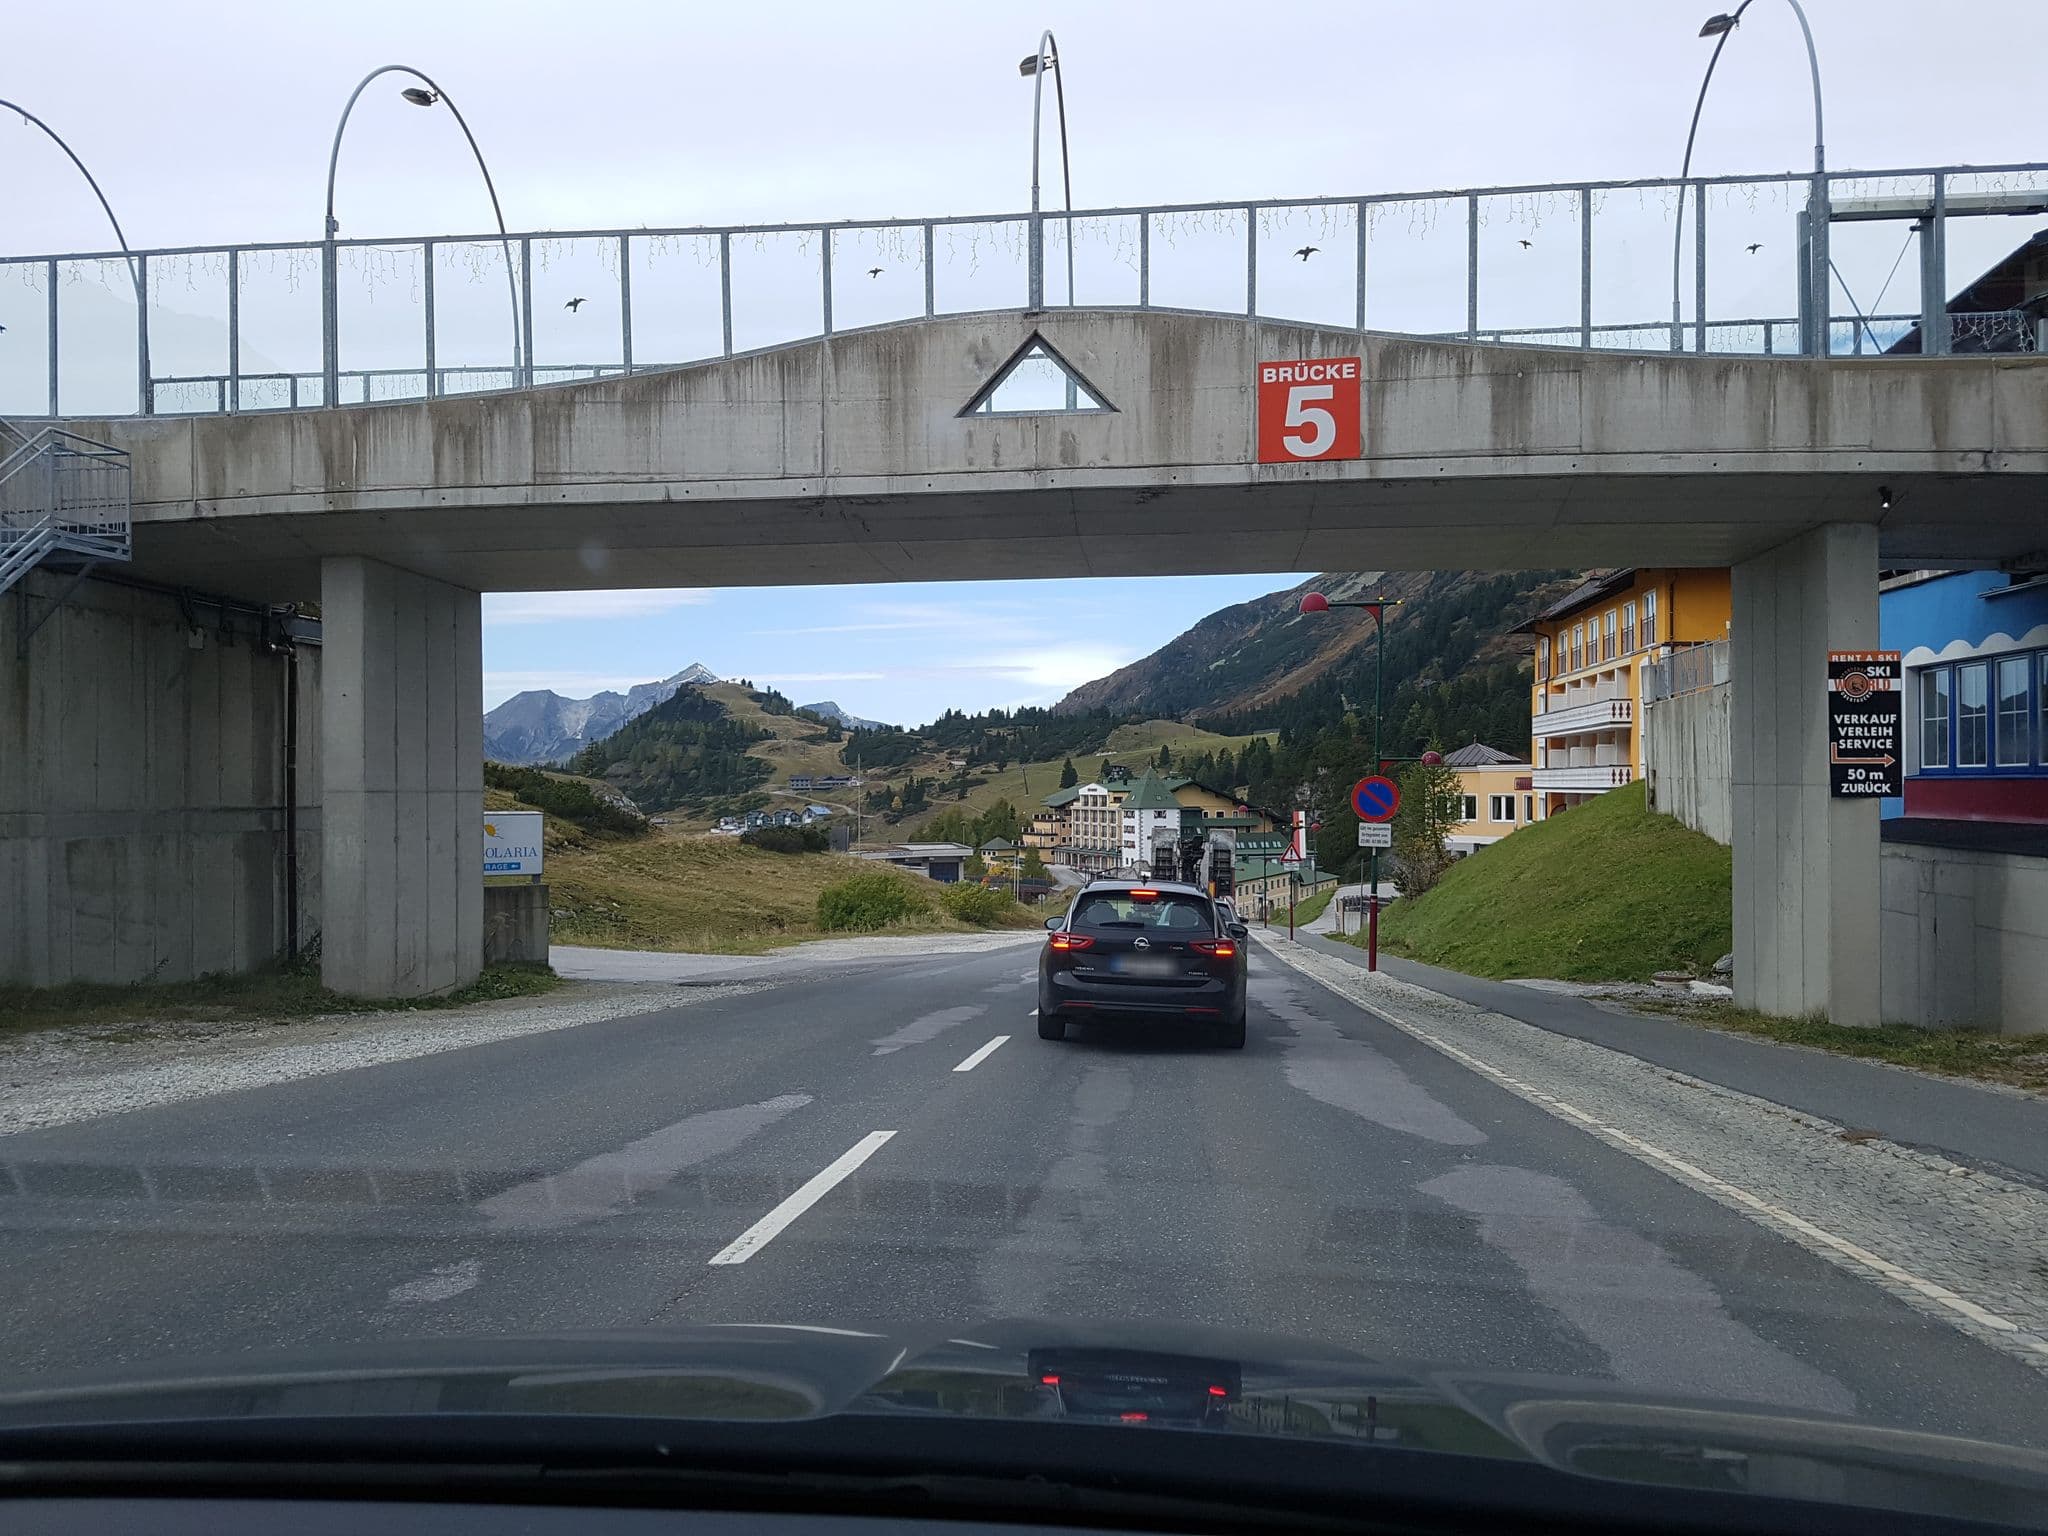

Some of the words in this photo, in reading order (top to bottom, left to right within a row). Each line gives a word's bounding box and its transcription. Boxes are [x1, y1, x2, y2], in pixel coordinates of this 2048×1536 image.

[1263, 362, 1356, 383] BRÜCKE
[1282, 384, 1337, 458] 5
[1831, 654, 1861, 662] RENT
[1866, 654, 1873, 662] A
[1878, 654, 1898, 662] SKI
[1866, 666, 1891, 677] SKI
[1833, 714, 1897, 724] VERKAUF
[1838, 726, 1893, 737] VERLEIH
[1838, 738, 1893, 749] SERVICE
[1847, 768, 1866, 780] 50
[1869, 771, 1884, 780] m
[1841, 781, 1892, 793] ZURÜCK
[483, 846, 538, 858] OLARIA
